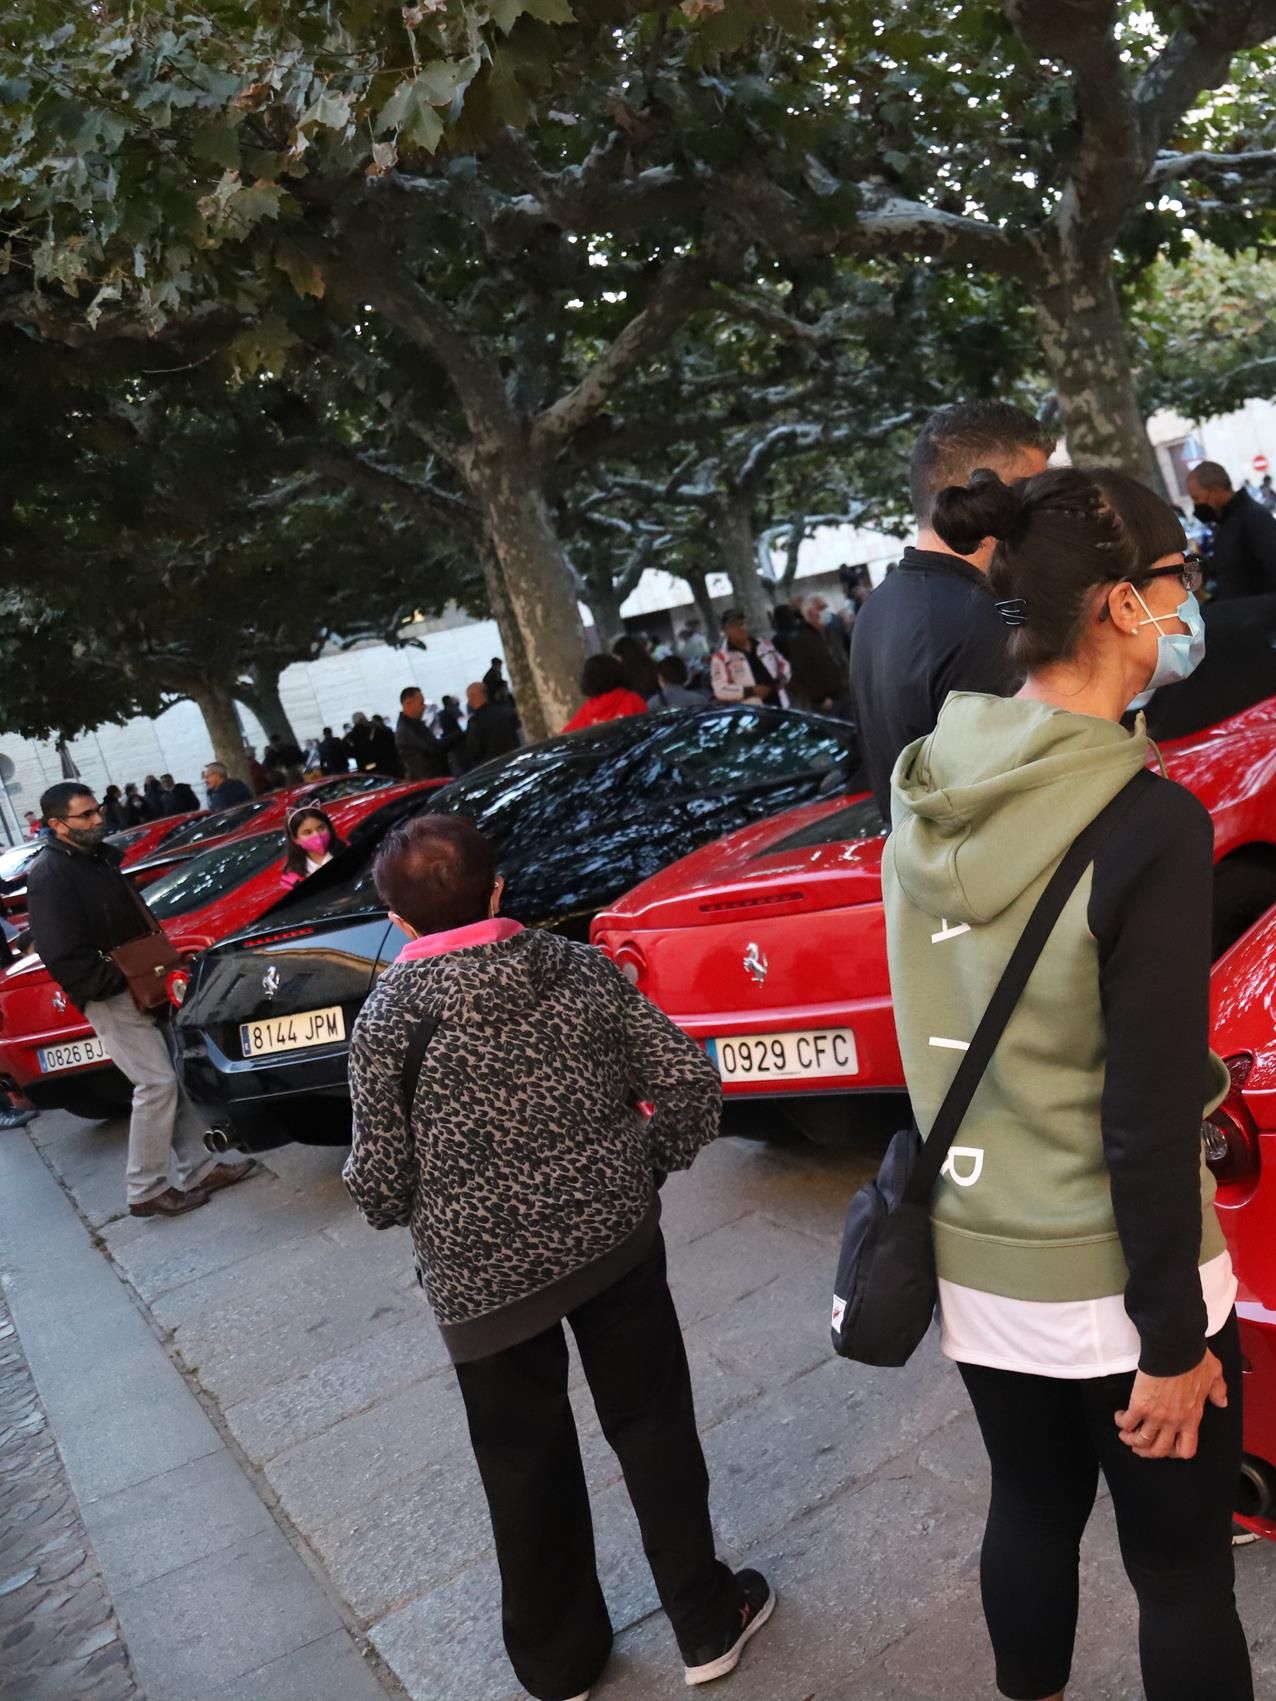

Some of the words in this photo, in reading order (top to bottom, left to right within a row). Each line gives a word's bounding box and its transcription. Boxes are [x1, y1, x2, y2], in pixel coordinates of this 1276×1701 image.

[253, 1020, 298, 1049] 8144
[305, 1012, 338, 1040] JPM
[46, 1045, 82, 1068] 0826
[84, 1040, 107, 1060] BJ
[722, 1039, 787, 1073] 0929
[797, 1034, 849, 1069] CFC
